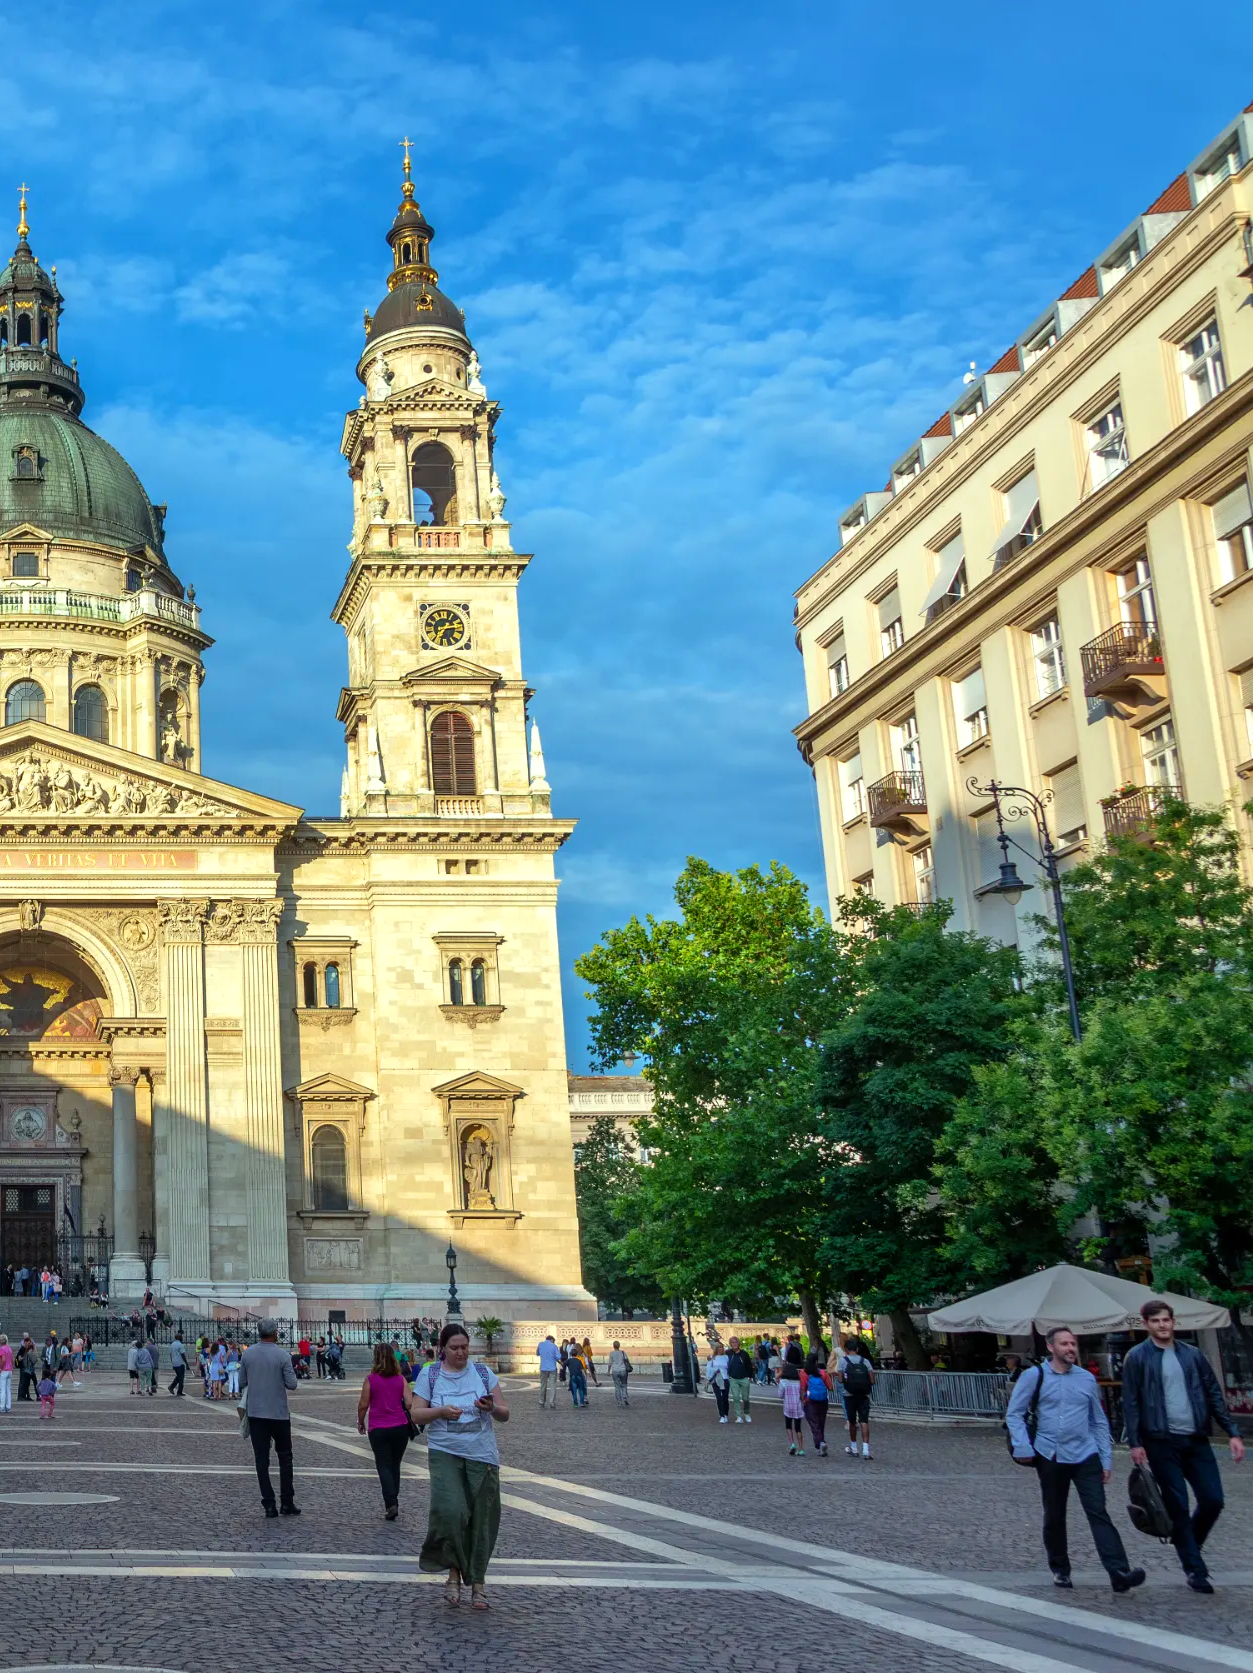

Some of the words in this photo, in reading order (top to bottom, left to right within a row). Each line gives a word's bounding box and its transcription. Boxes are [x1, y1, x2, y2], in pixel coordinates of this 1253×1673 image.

[25, 853, 96, 867] VERITAS
[108, 853, 129, 867] ET
[140, 853, 177, 867] VITA
